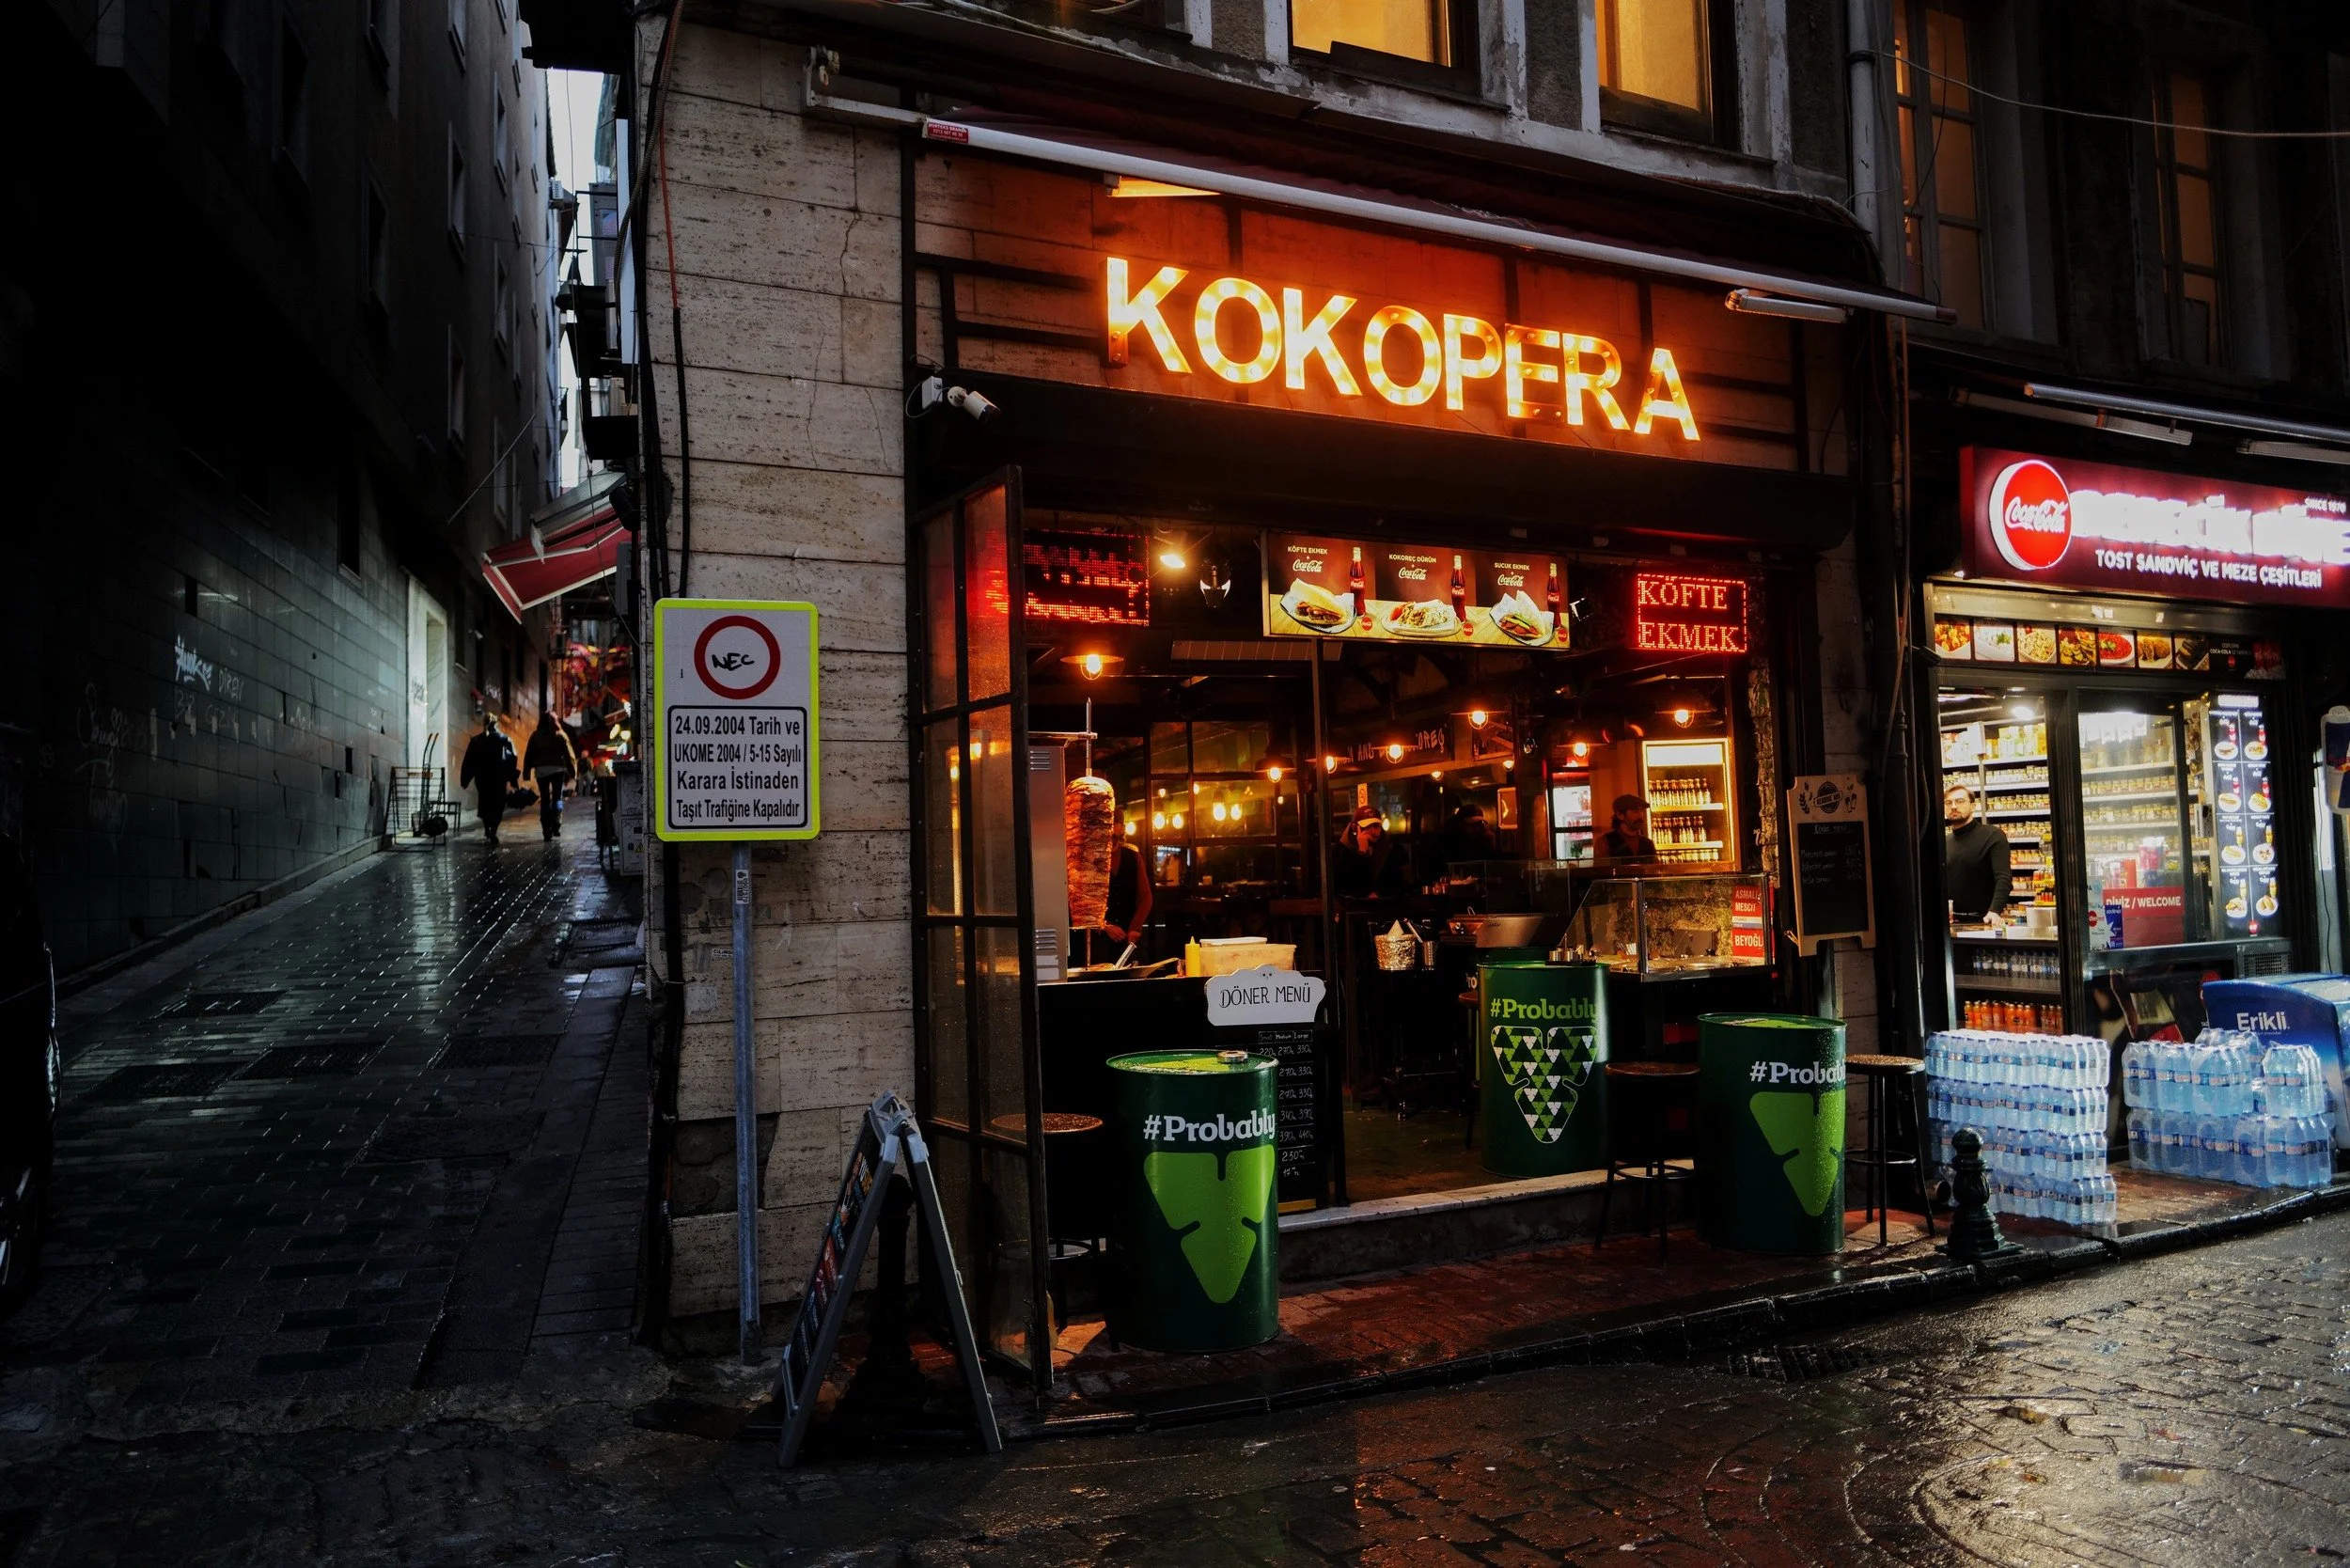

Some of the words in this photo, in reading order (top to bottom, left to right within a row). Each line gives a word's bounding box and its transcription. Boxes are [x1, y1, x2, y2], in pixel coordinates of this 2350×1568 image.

[1104, 256, 1700, 442] KOKOPERA
[2005, 496, 2068, 533] Coca-Cola
[1288, 545, 1308, 554] KÖFTE
[1389, 554, 1416, 562] KOKOREÇ
[2095, 549, 2134, 570] TOST
[2136, 555, 2199, 578] SANDVİÇ
[2201, 560, 2218, 578] VE
[2222, 562, 2257, 582] MEZE
[2260, 564, 2322, 588] ÇEŞİTLERİ
[1639, 576, 1728, 609] KÖFTE
[1639, 622, 1739, 651] EKMEK
[712, 652, 755, 671] NEC
[675, 715, 745, 735] 24.09.2004
[749, 716, 781, 735] Tarih
[785, 722, 800, 735] ve
[675, 744, 714, 762] UKOME
[716, 744, 741, 762] 2004
[743, 744, 747, 762] /
[749, 744, 771, 762] 5-15
[774, 744, 802, 767] Sayılı
[677, 771, 727, 790] Karara
[731, 766, 798, 790] İstinaden
[677, 800, 702, 823] Taşıt
[704, 799, 750, 823] Trafiğine
[753, 799, 800, 822] Kapalıdır
[1735, 890, 1758, 900] ASMALI
[2138, 896, 2182, 908] WELCOME
[1735, 902, 1756, 912] MESCİT
[1219, 985, 1270, 1008] DÖNER
[1276, 982, 1310, 1003] MENÜ
[2237, 1011, 2289, 1032] Erikli
[1143, 1107, 1276, 1142] #Probably
